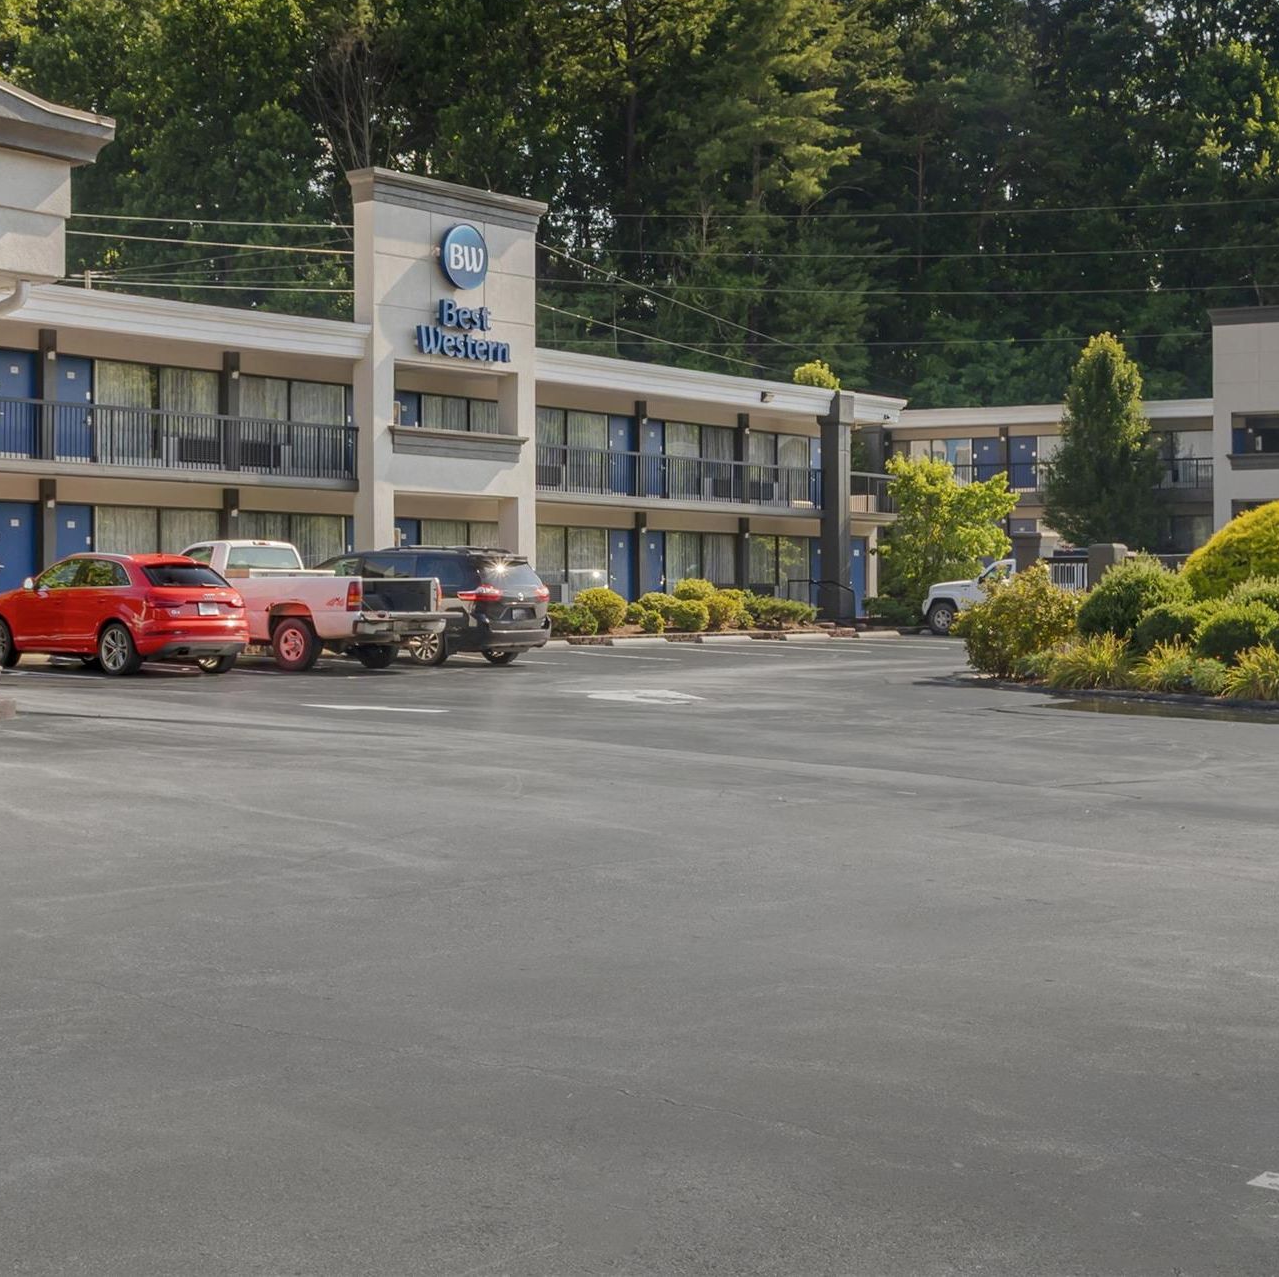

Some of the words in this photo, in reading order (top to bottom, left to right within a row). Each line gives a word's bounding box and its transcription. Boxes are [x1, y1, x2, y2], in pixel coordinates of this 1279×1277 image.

[449, 243, 484, 273] BW
[439, 298, 491, 332] Best
[416, 324, 511, 363] Western
